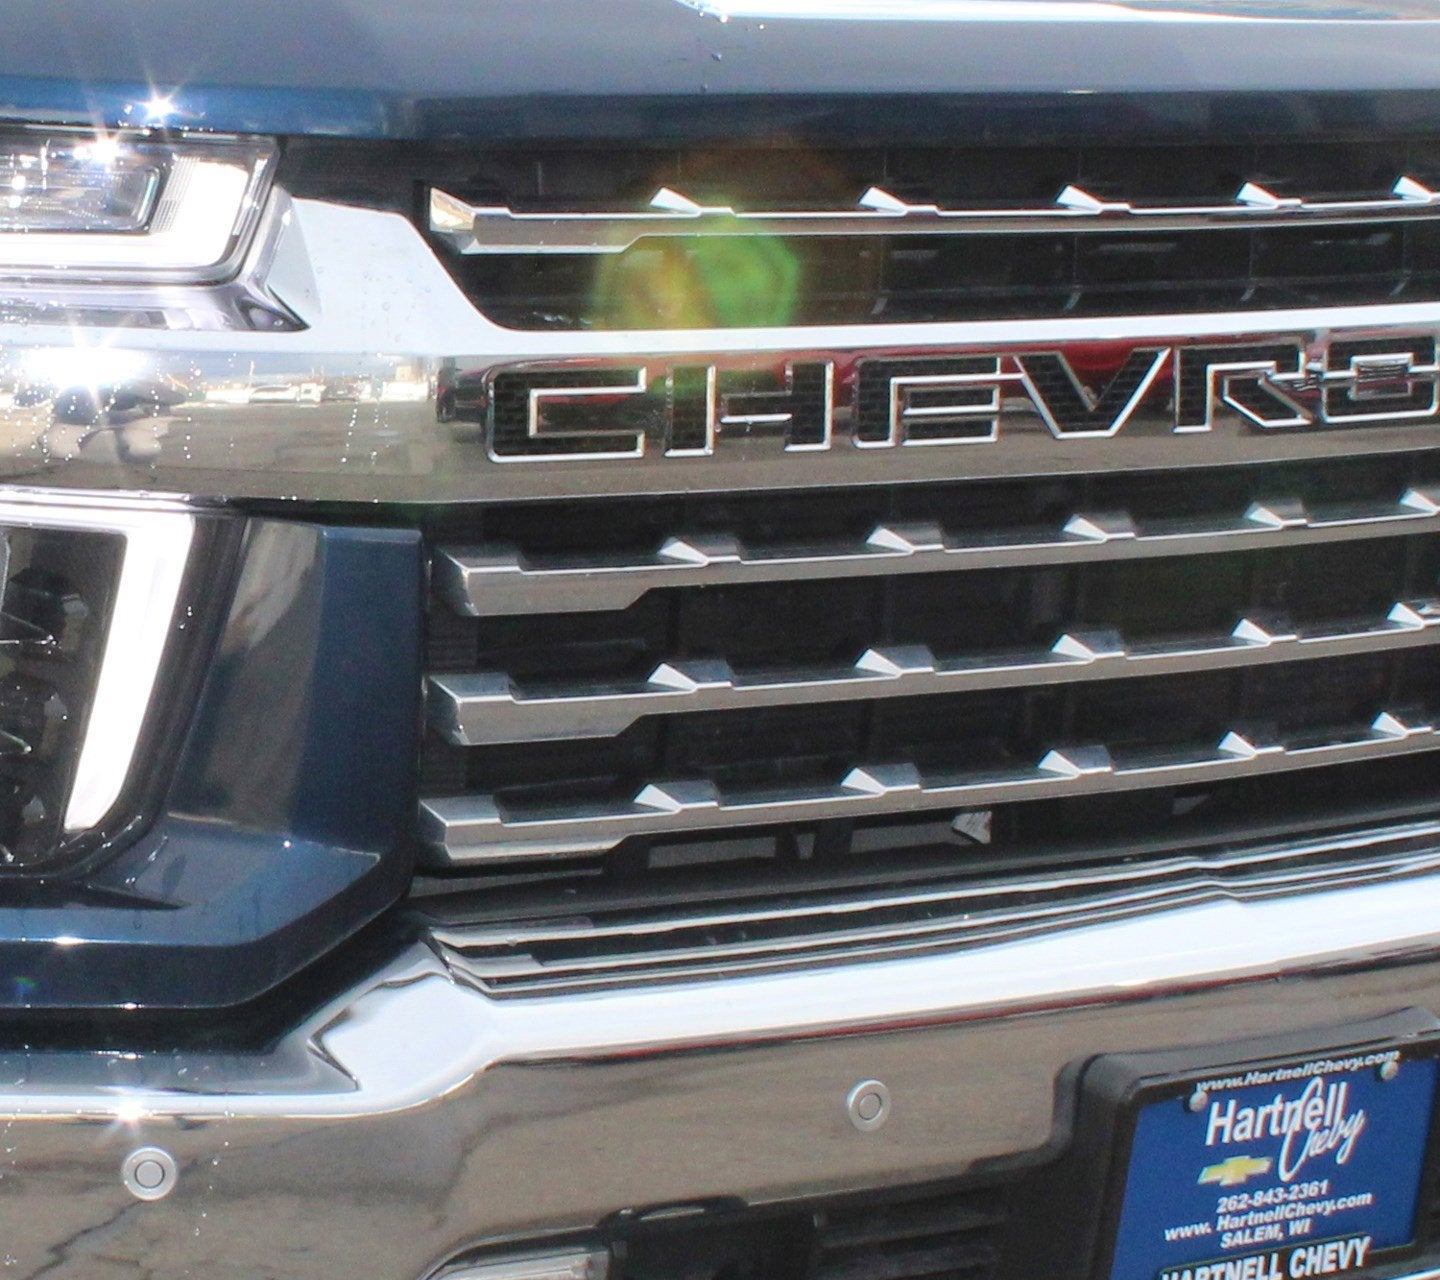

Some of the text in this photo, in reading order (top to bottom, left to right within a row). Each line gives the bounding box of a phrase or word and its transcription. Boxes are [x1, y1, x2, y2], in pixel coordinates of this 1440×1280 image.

[1196, 1050, 1401, 1092] www.HartnellChevy.com
[1205, 1081, 1348, 1146] Hartnell
[1164, 1192, 1373, 1241] www. HartnellChevy.com
[1216, 1179, 1329, 1214] 262-843-2361
[1220, 1218, 1313, 1249] SALEM, WI
[1289, 1235, 1372, 1279] CHEVY
